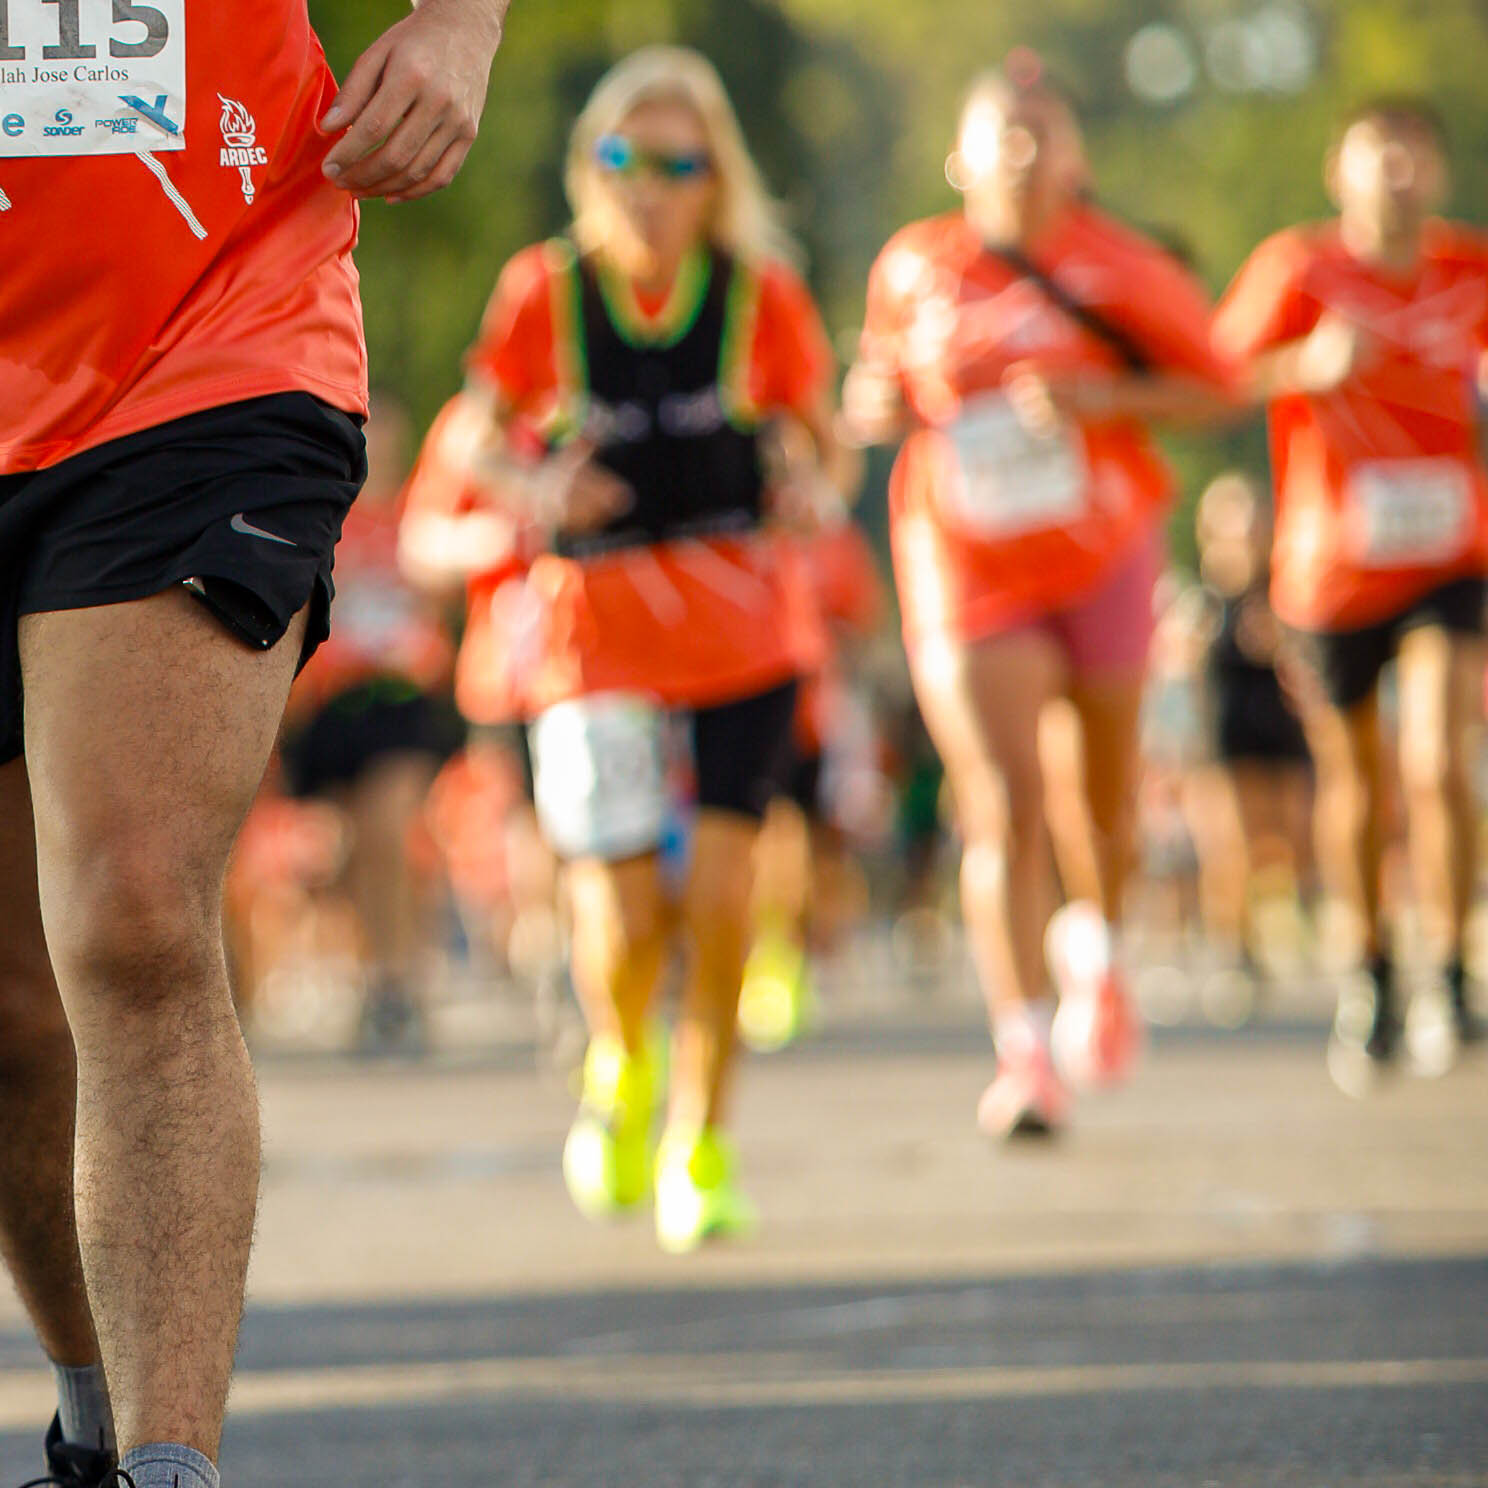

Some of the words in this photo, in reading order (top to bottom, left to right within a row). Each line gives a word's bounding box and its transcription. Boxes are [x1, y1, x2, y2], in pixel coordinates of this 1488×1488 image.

[31, 66, 68, 83] Jose
[74, 65, 129, 82] Carlos
[219, 146, 268, 166] ARDEC
